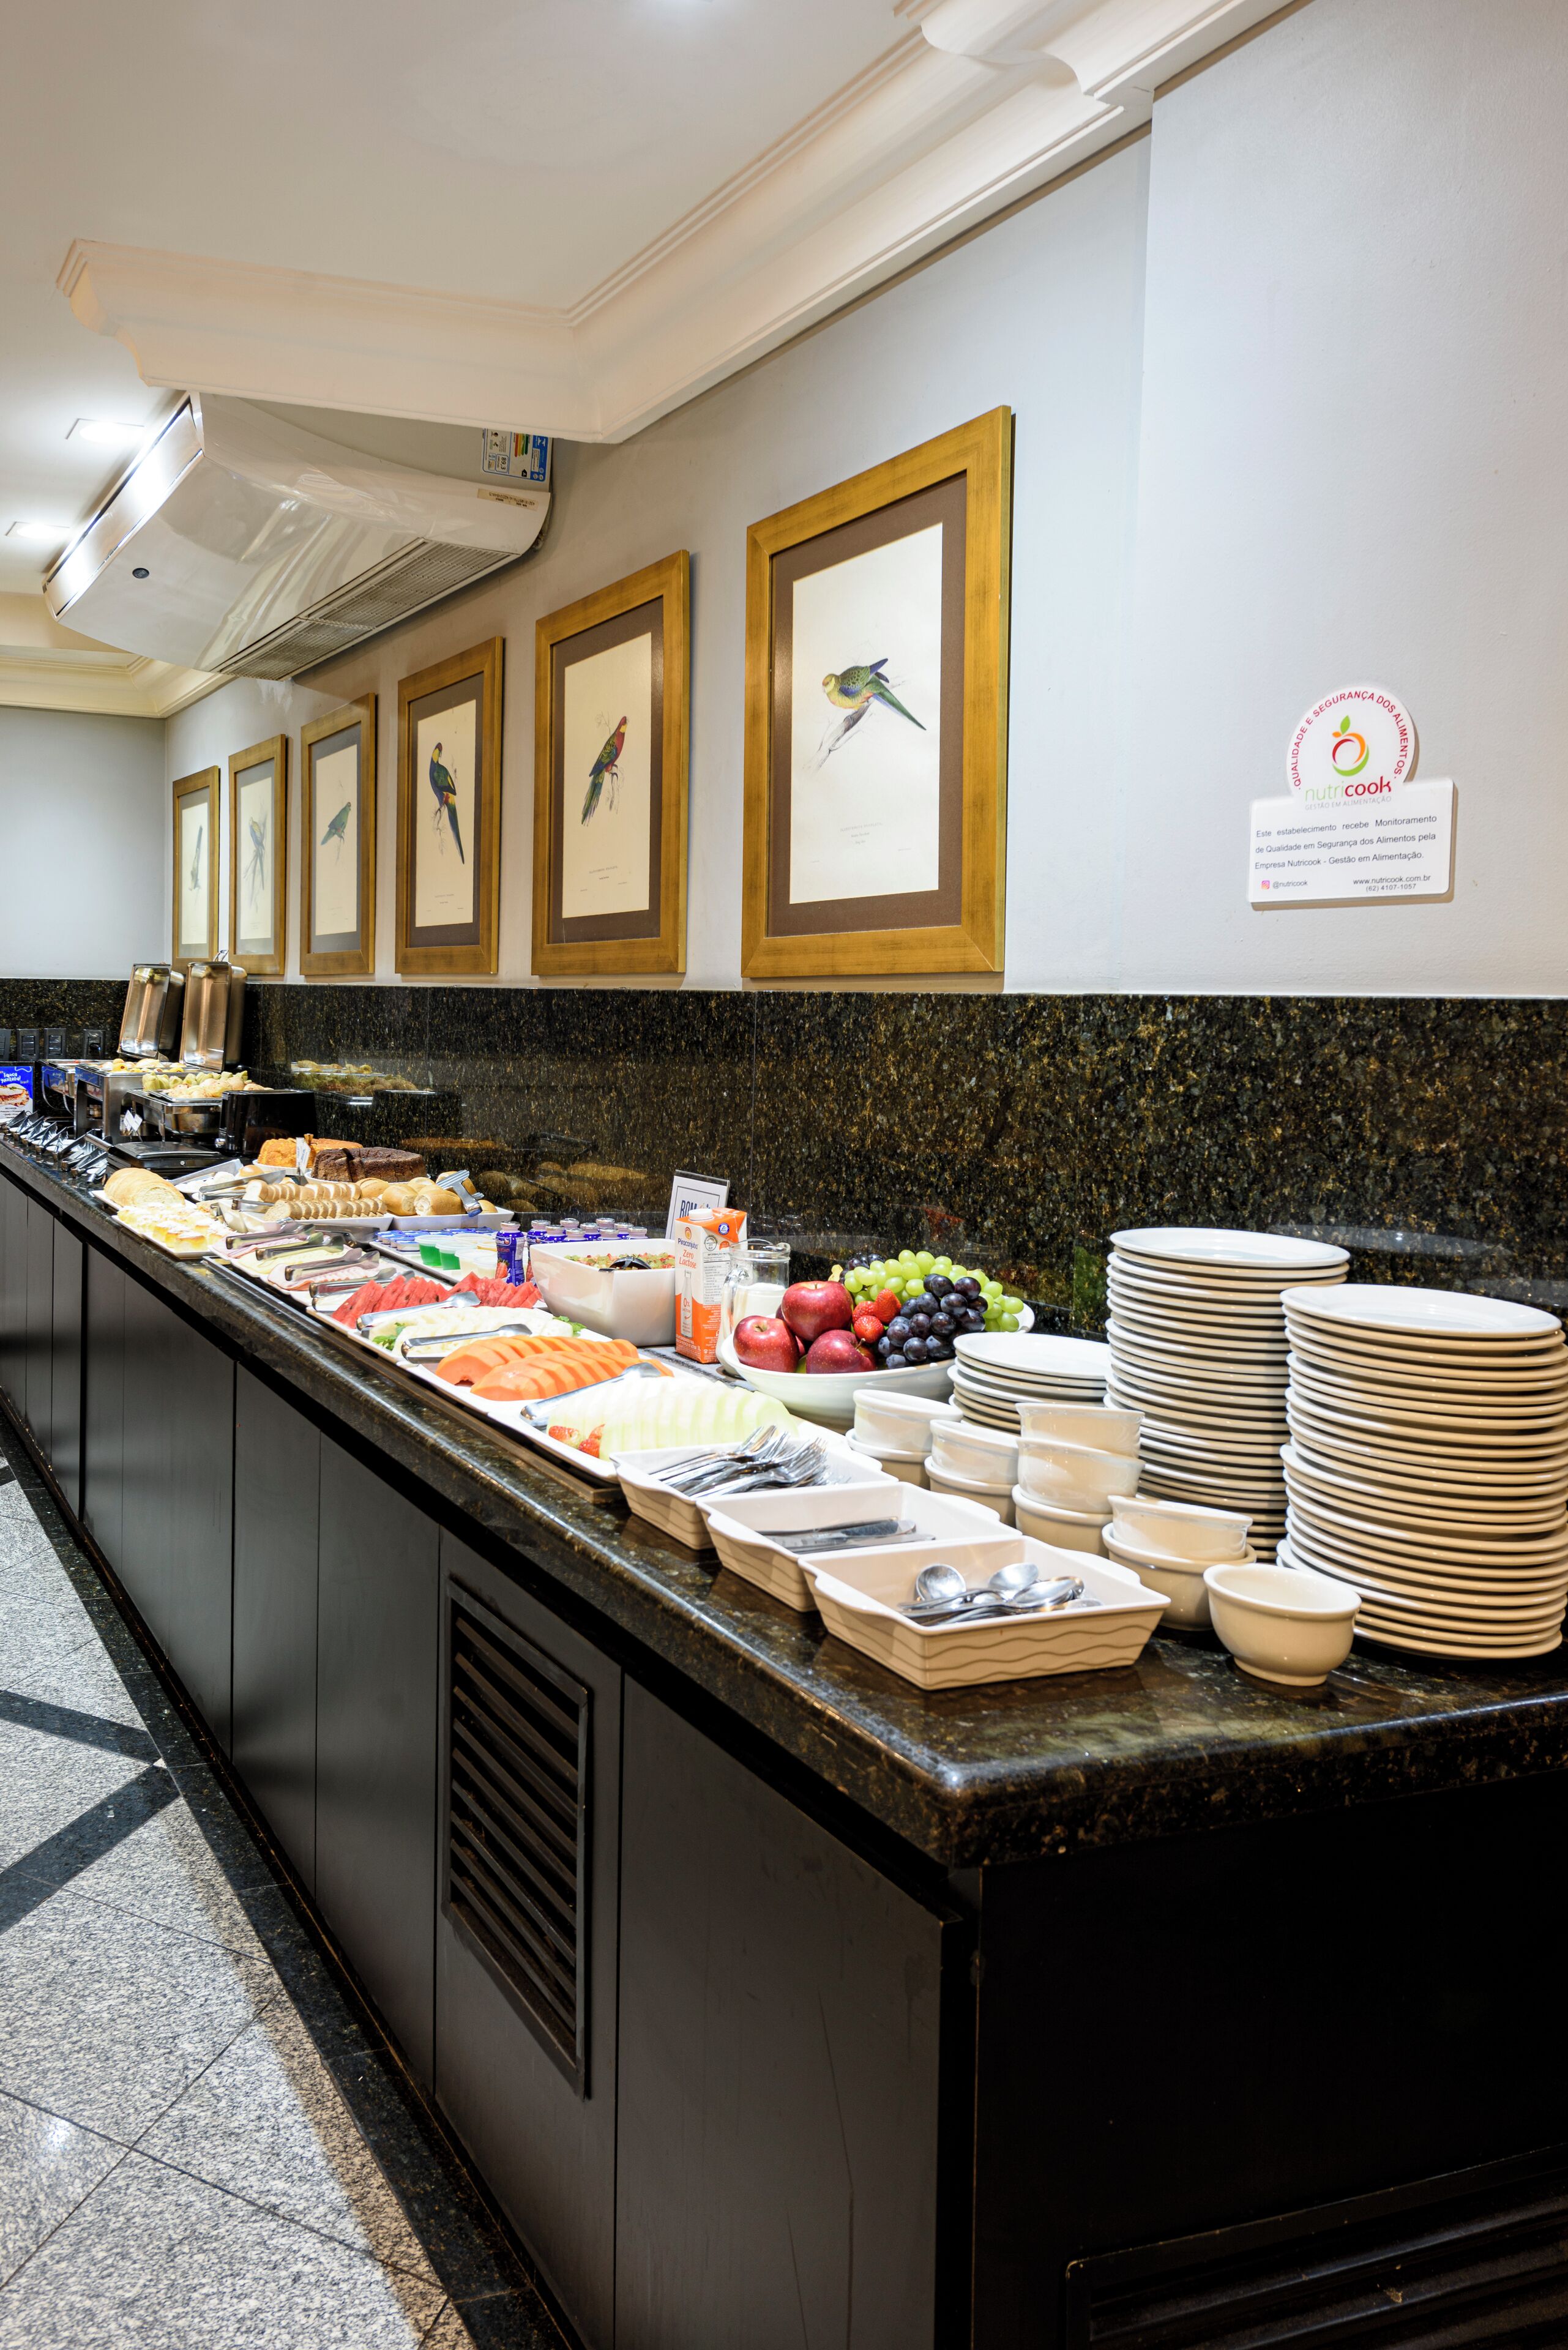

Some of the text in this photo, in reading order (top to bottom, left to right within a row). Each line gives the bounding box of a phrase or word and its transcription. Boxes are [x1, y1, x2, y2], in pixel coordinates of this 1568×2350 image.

[1291, 726, 1308, 786] QUALIDADE
[1313, 690, 1375, 717] SEGURANÇA
[1376, 695, 1395, 713] DOS
[1392, 713, 1408, 775] ALIMENTOS
[1305, 775, 1392, 801] nutricook
[1305, 802, 1330, 810] GESTÃO
[1342, 796, 1392, 807] ALIMENTAÇÃO
[1277, 824, 1337, 836] estabelecimento
[1342, 821, 1369, 830] recebe
[1375, 815, 1437, 827] Monitoramento
[1266, 843, 1302, 853] Qualidade
[1317, 839, 1357, 849] Segurança
[1376, 834, 1416, 844] Alimentos
[1418, 832, 1436, 842] pela
[1255, 861, 1285, 870] Empresa
[1287, 858, 1321, 867] Nutricook
[1328, 856, 1356, 865] Gestão
[1372, 851, 1424, 862] Alimentação.
[1272, 880, 1308, 889] @nutricook
[1353, 875, 1432, 885] www.nutricook.com.br
[678, 1237, 698, 1249] Piracanjuba
[683, 1249, 694, 1259] Zero
[679, 1256, 696, 1269] Lactose
